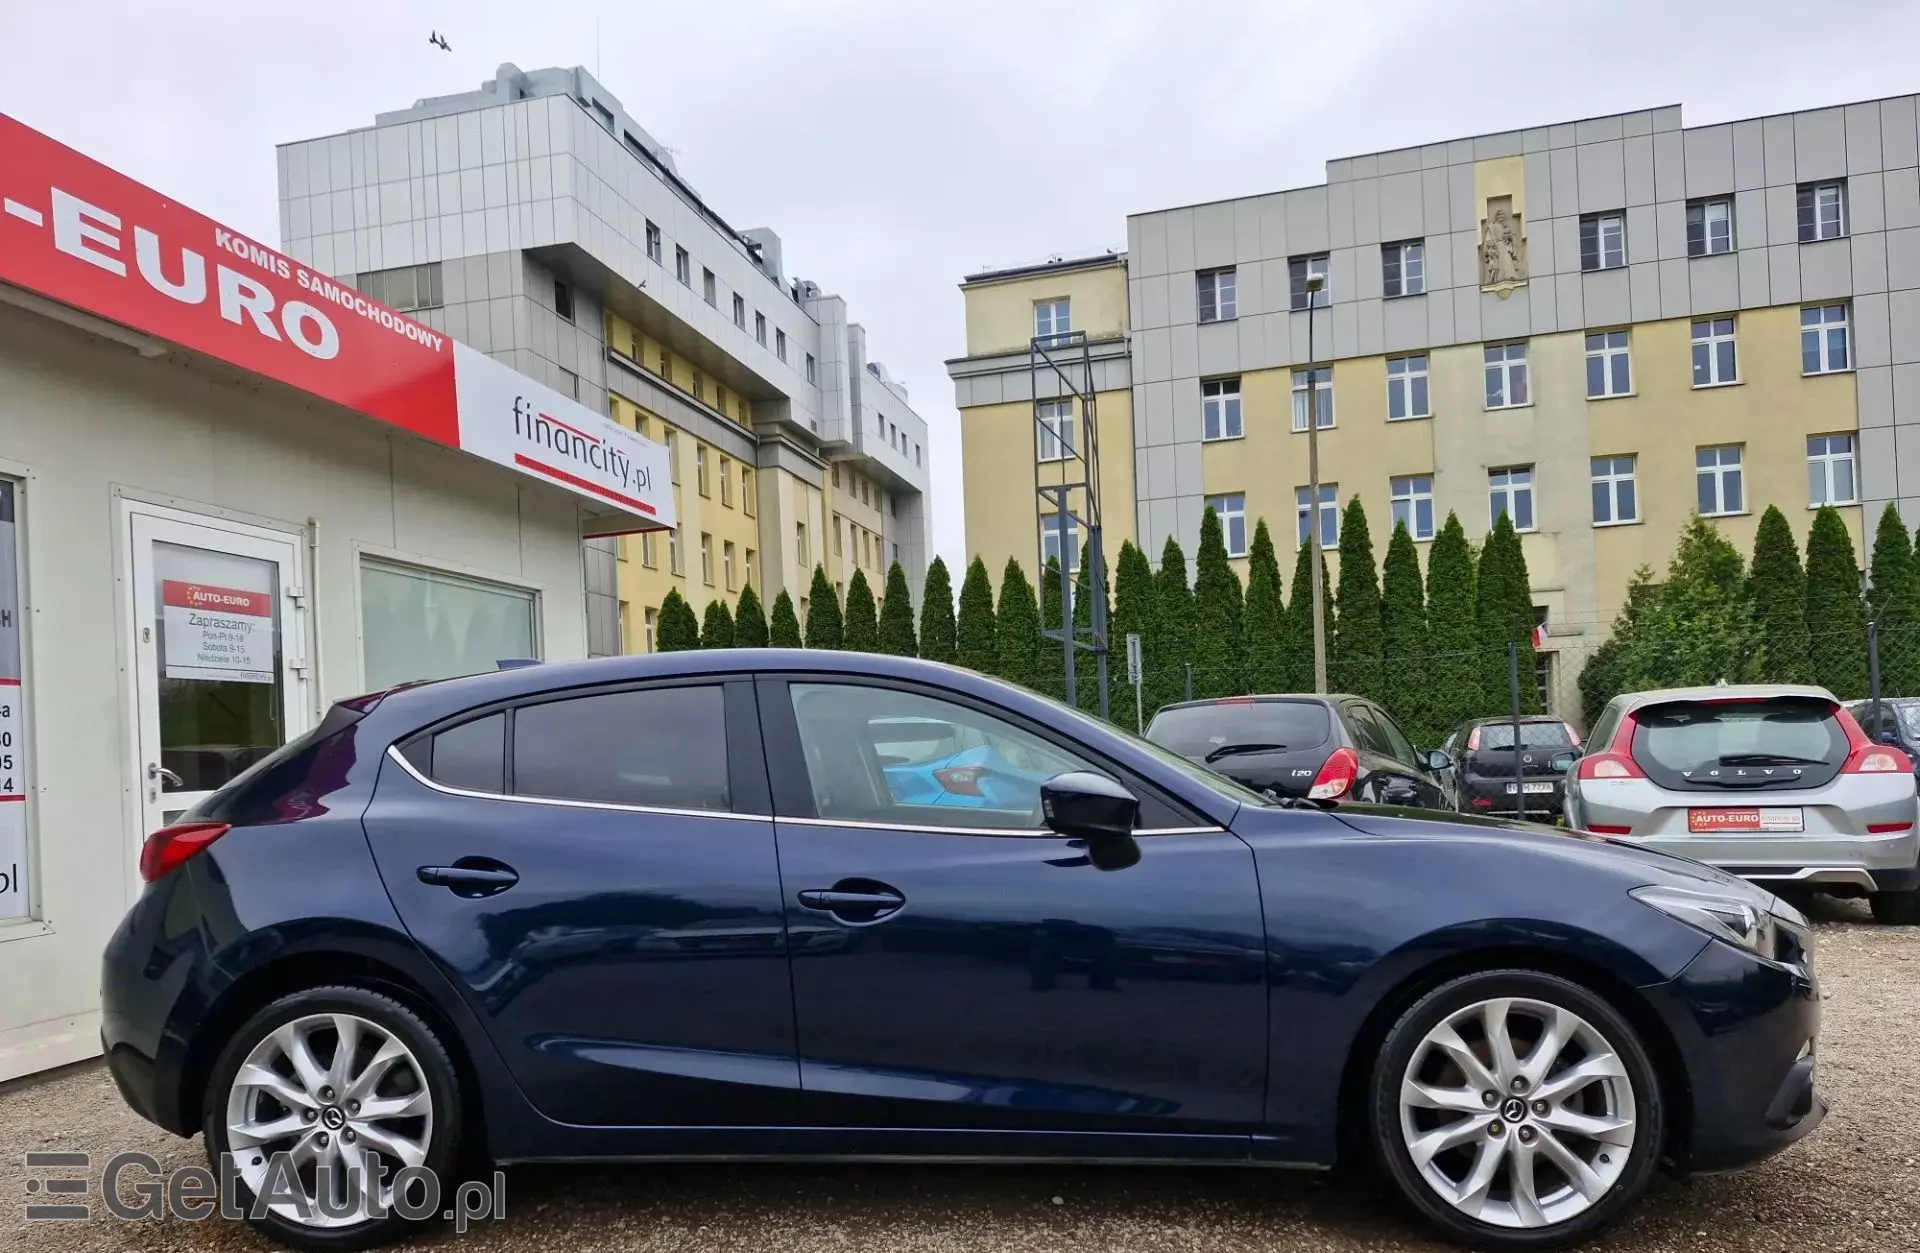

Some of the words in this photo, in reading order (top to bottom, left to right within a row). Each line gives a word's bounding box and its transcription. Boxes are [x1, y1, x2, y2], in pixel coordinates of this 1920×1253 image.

[215, 228, 291, 279] KOMIS
[296, 269, 443, 352] SAMOCHODOWY
[512, 396, 651, 493] financity.pl
[193, 592, 250, 607] AUTO-EURO
[1682, 768, 1802, 777] VOLVO
[1696, 814, 1759, 823] AUTO-EURO
